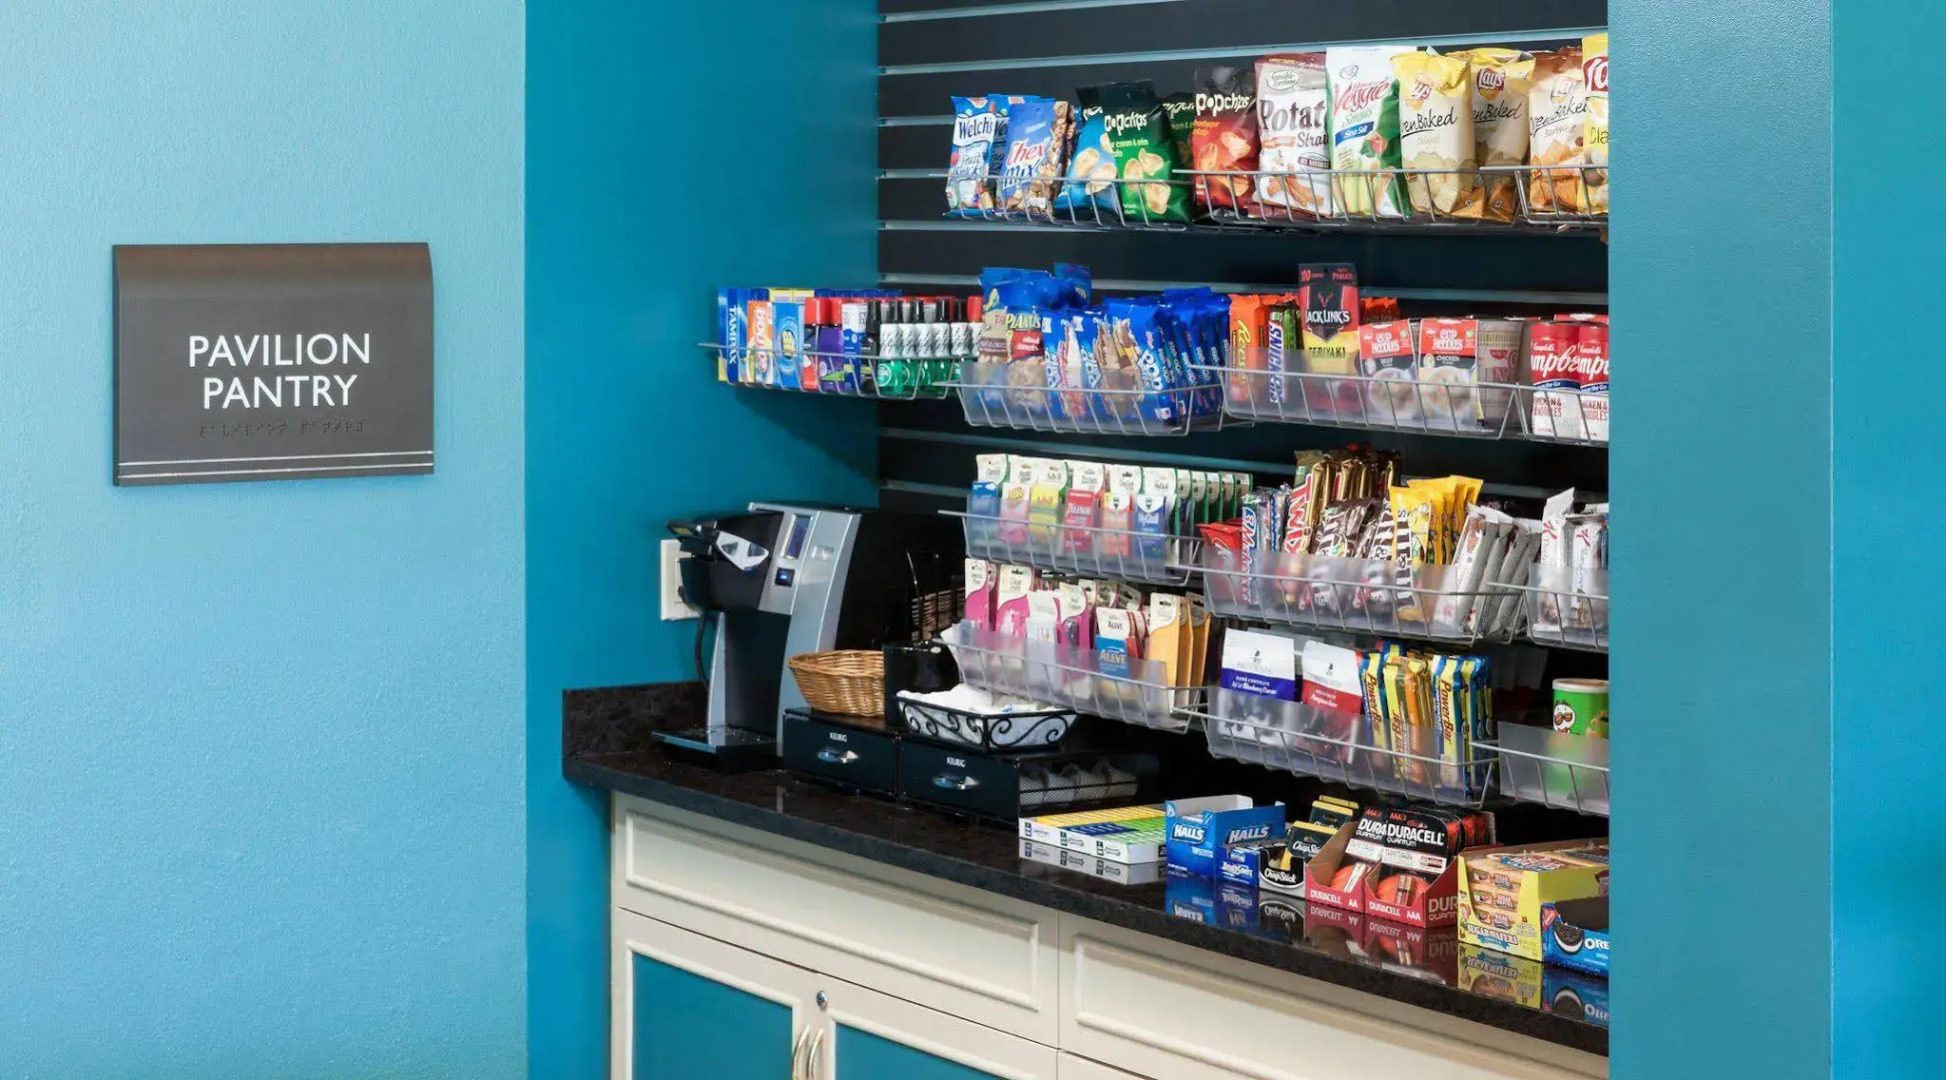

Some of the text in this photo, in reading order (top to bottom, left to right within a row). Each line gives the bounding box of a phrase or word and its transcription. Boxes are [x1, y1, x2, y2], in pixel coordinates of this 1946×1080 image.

[1195, 92, 1250, 117] popchips
[1333, 80, 1390, 117] Veggie
[1104, 112, 1148, 136] popchips
[1259, 100, 1326, 131] Potat
[958, 116, 993, 139] Welch's
[1007, 140, 1045, 167] Chex
[728, 305, 737, 364] TAMPAX
[189, 333, 371, 367] PAVILION
[1309, 347, 1345, 358] TERIYAKI
[203, 374, 358, 410] PANTRY
[1099, 649, 1126, 664] ALEVE
[1367, 671, 1382, 732] PowerBar
[1441, 679, 1454, 745] PowerBar
[829, 732, 847, 742] KEURIG
[946, 756, 965, 767] KEURIG
[1174, 824, 1205, 840] HALLS
[1228, 826, 1270, 843] HALLS
[1387, 823, 1444, 846] DURACELL
[1387, 836, 1416, 847] QUANTUM
[1264, 867, 1296, 883] ChapStick
[1310, 890, 1359, 908] DURACELL AA
[1369, 901, 1422, 921] DURACELL AAA
[1584, 937, 1610, 950] ORE
